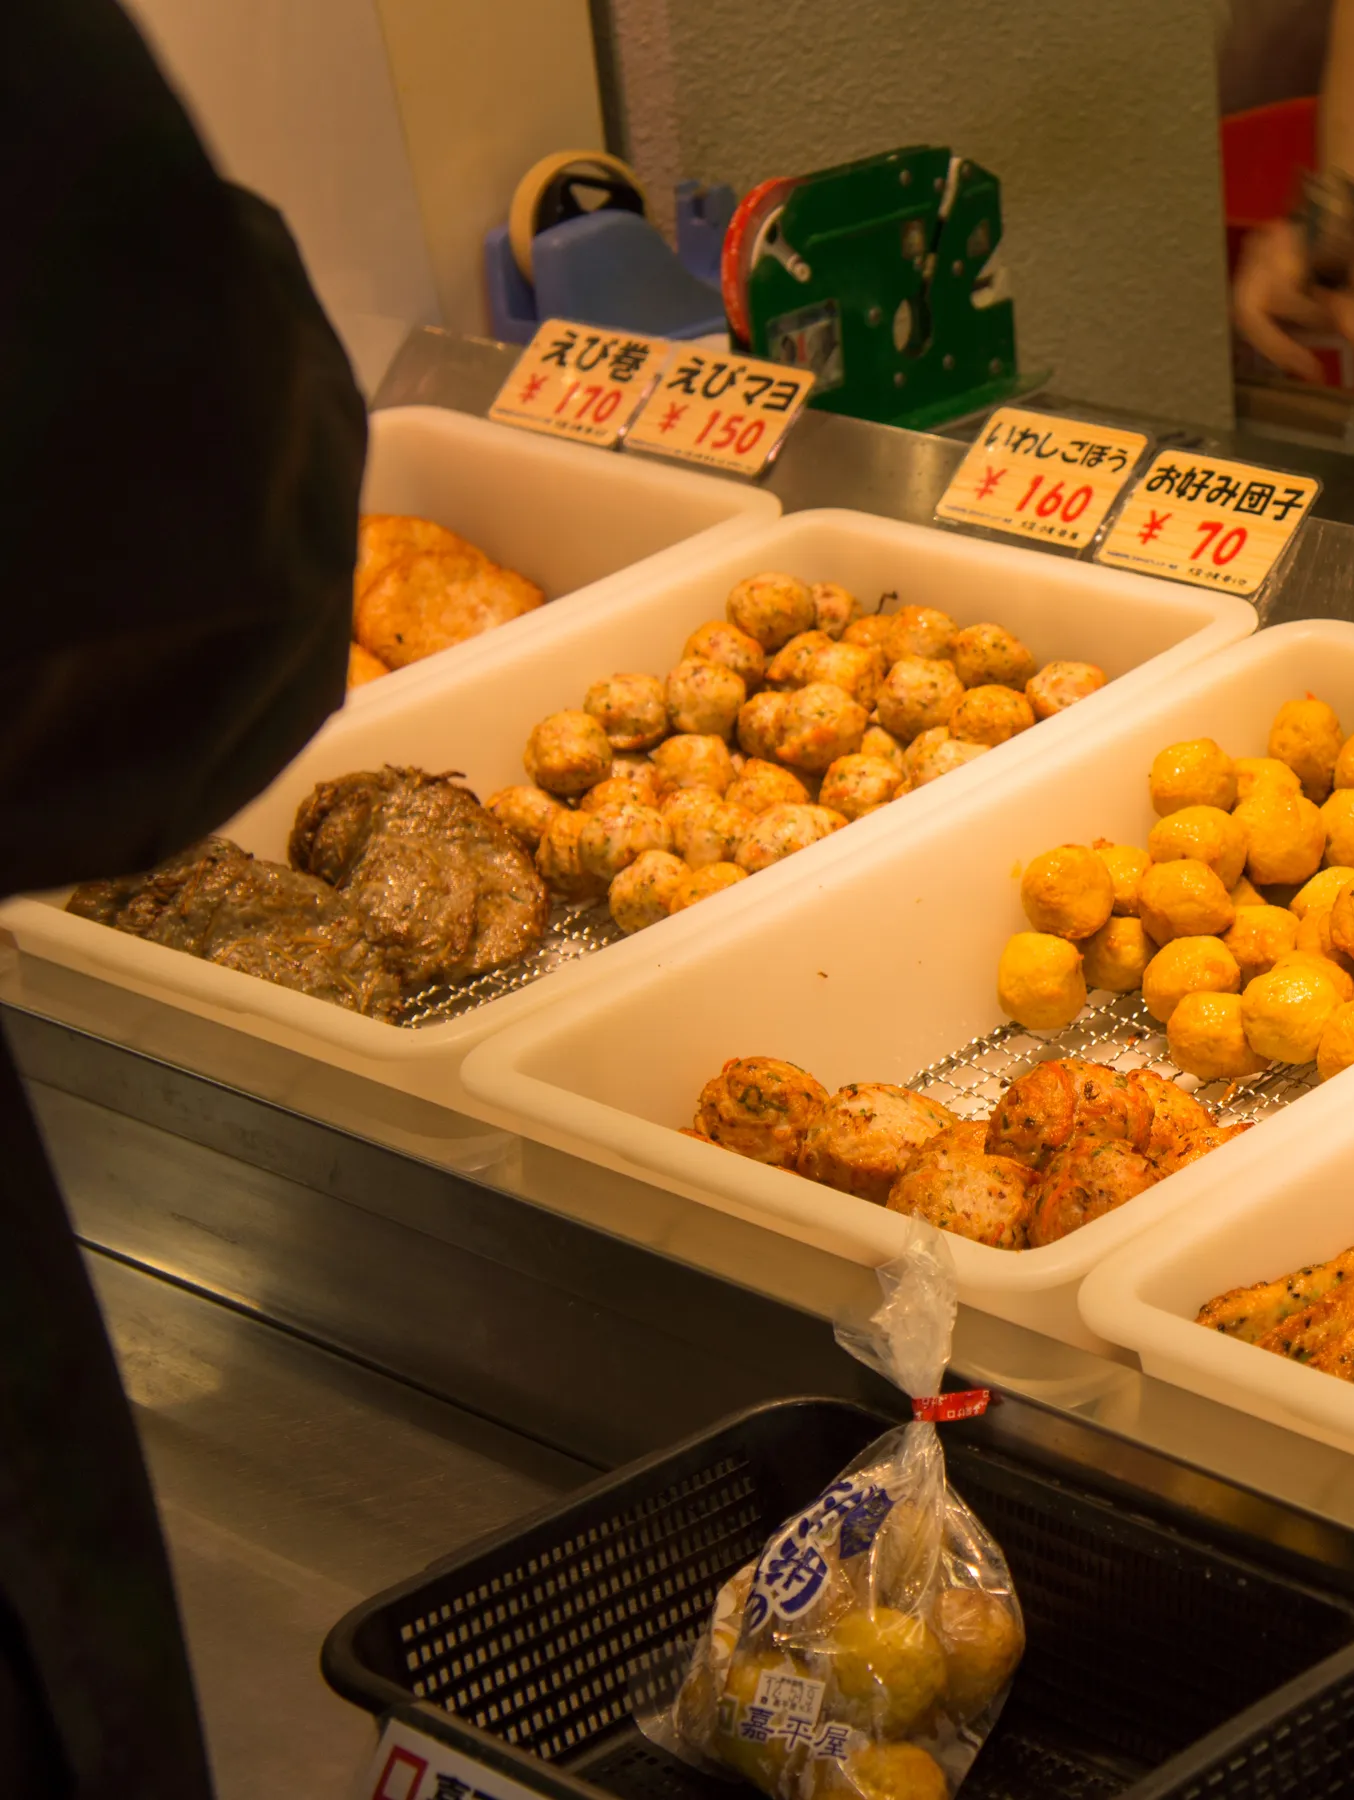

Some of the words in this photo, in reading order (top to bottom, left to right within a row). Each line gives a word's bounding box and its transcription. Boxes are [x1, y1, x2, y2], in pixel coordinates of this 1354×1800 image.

[541, 330, 649, 383] えび巻
[554, 381, 622, 424] 170
[667, 356, 800, 412] えびマヨ
[695, 410, 766, 455] 150
[1015, 474, 1094, 523] 160
[1145, 464, 1304, 521] お好み団子
[1189, 521, 1248, 566] 70
[741, 1706, 849, 1761] 嘉平屋
